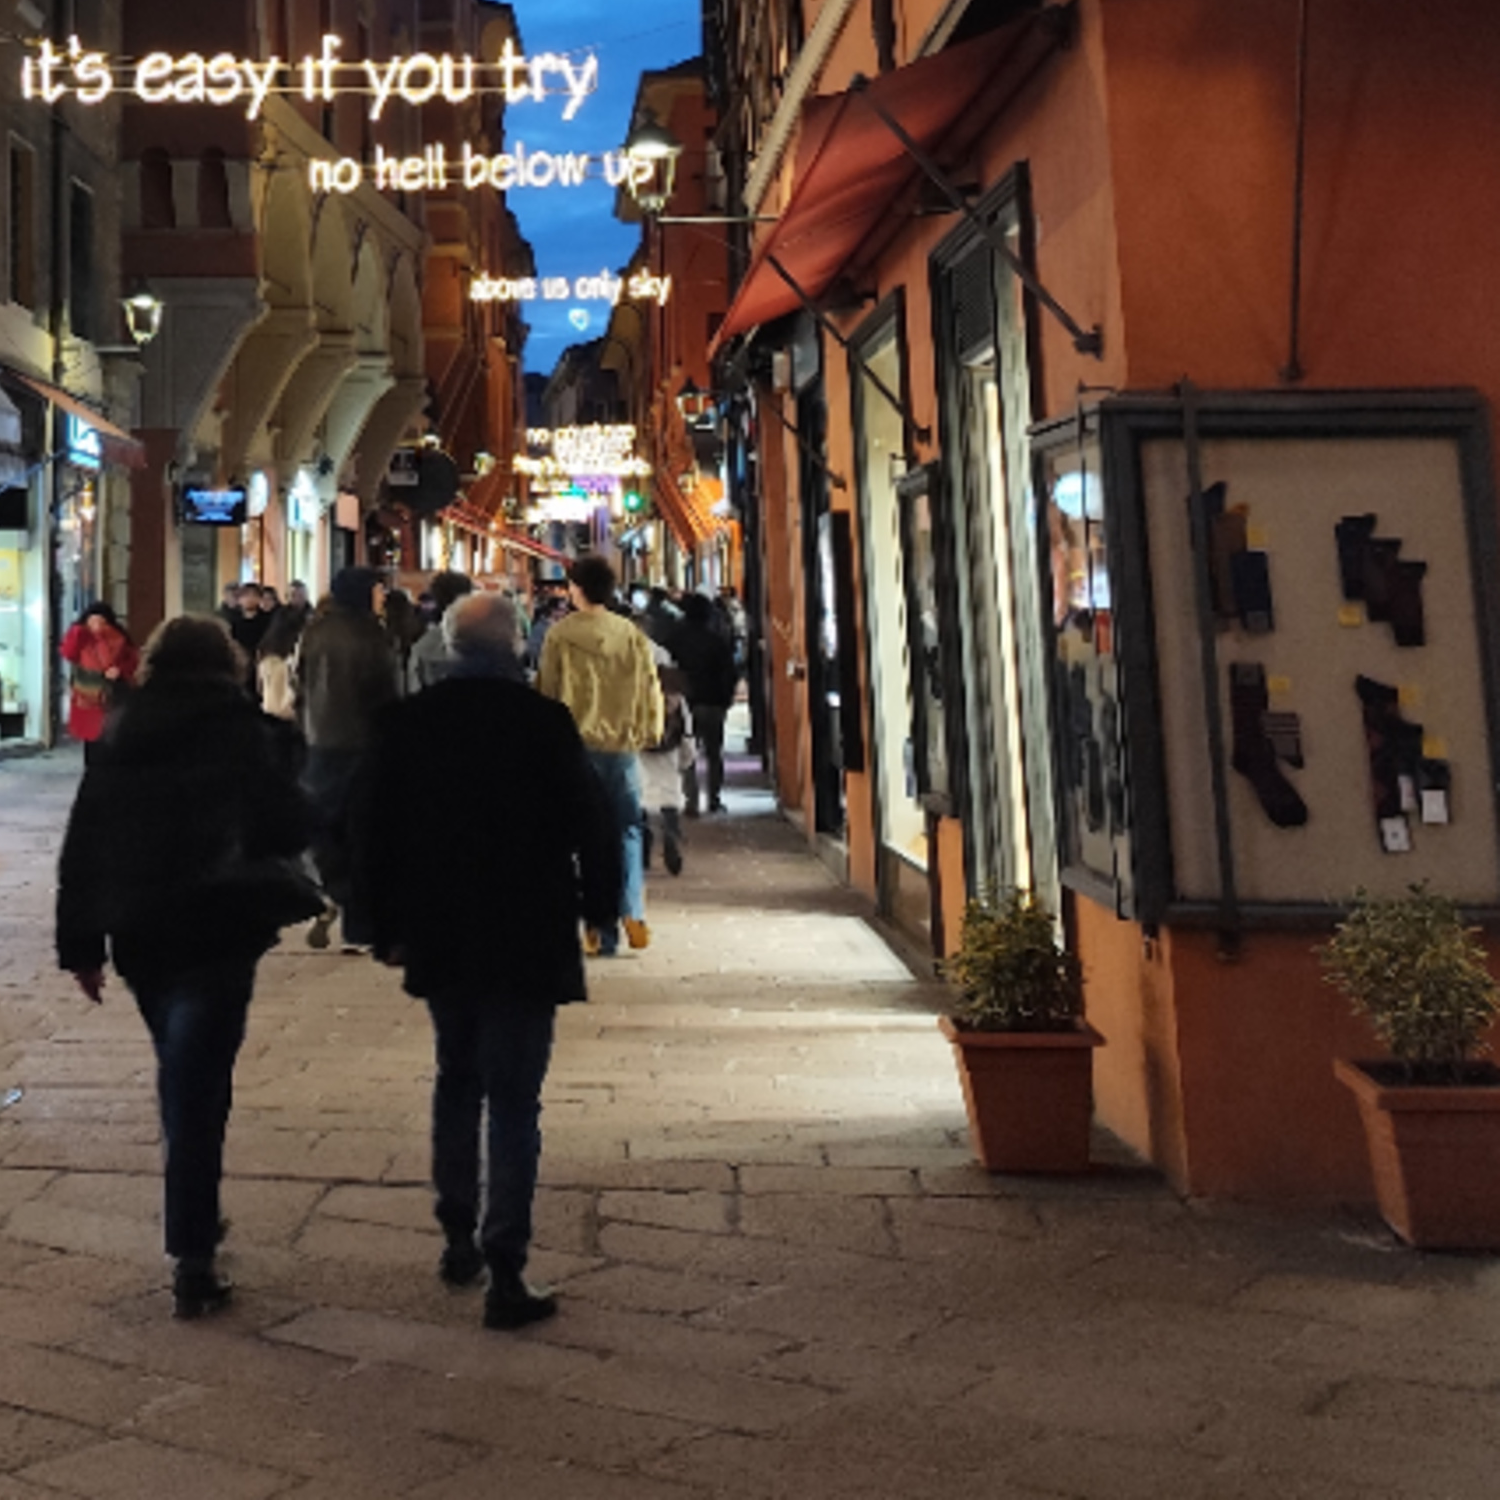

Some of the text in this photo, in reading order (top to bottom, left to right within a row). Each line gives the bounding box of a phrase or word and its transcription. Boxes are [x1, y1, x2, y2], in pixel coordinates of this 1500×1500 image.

[21, 33, 599, 120] it's easy if you try
[308, 156, 361, 193] no
[374, 143, 448, 190] hell
[462, 140, 588, 190] below
[470, 266, 672, 306] above us only sky
